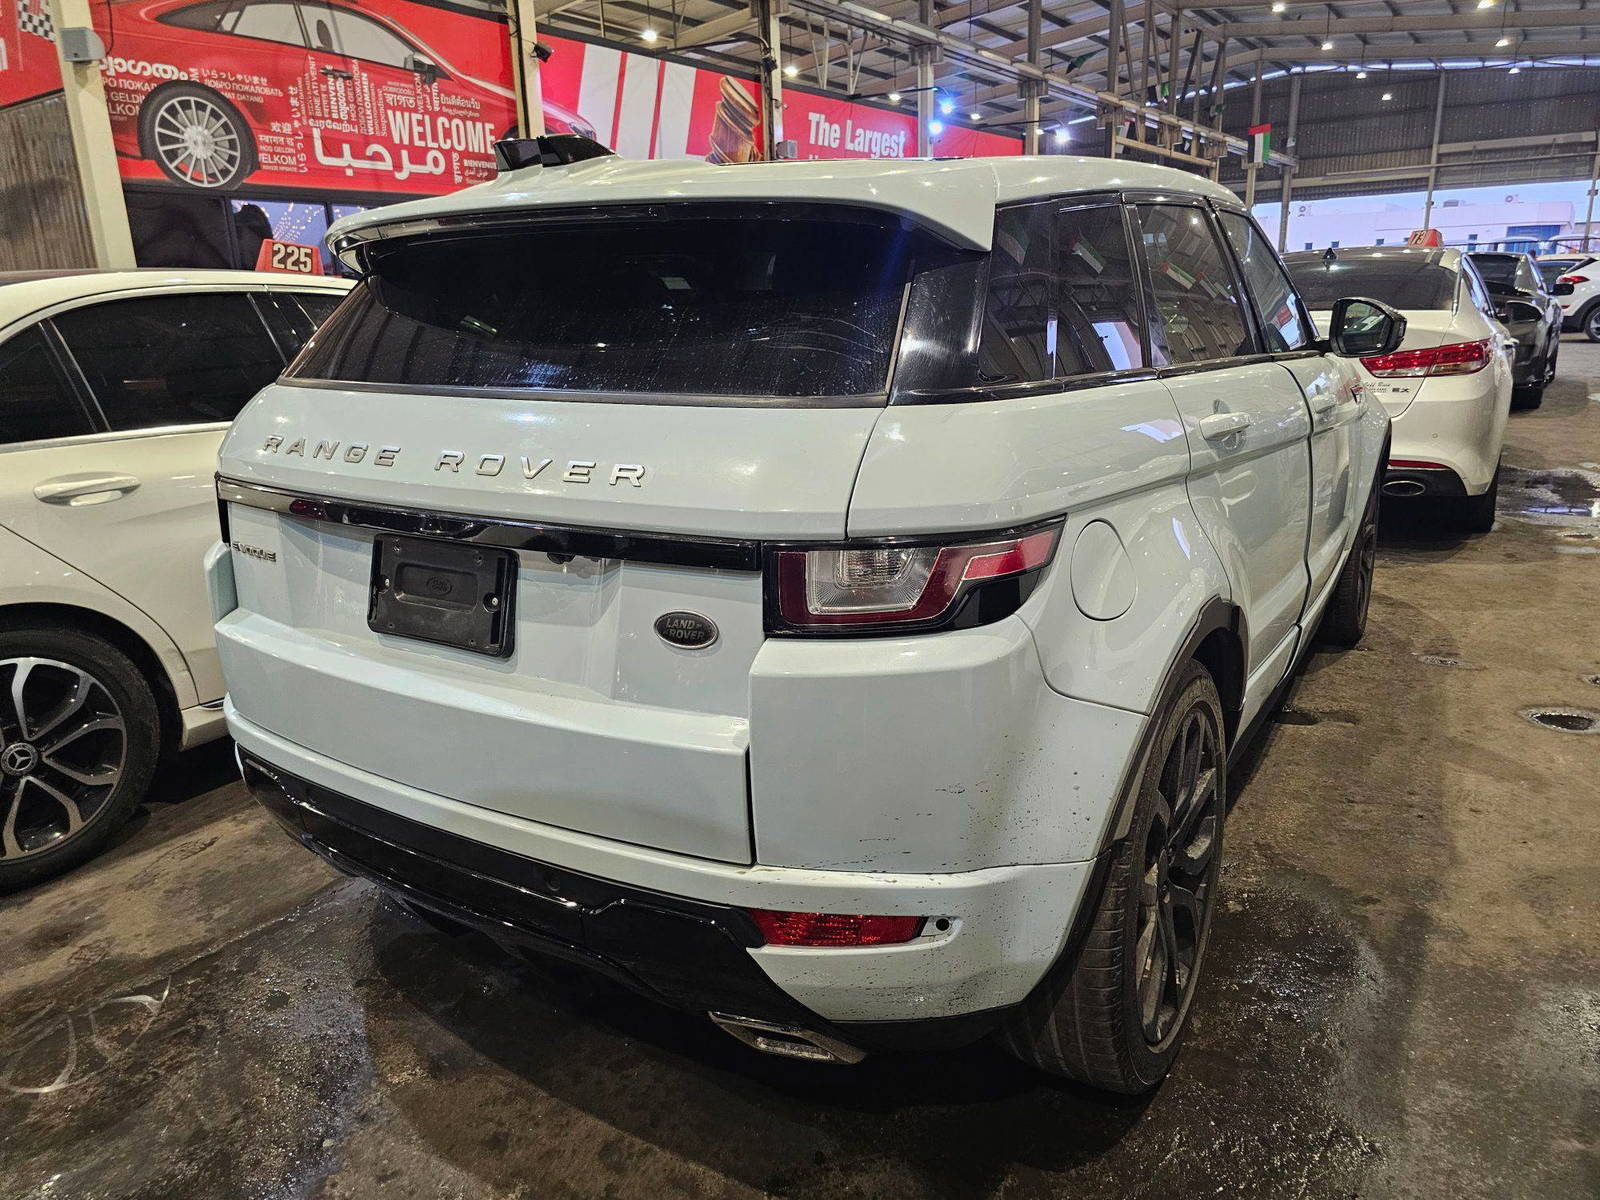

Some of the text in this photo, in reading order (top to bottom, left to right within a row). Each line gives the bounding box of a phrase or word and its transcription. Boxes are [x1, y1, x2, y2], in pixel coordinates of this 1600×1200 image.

[361, 72, 374, 135] WILLKOMMEN
[312, 127, 446, 180] مرحبا
[387, 109, 496, 154] WELCOME
[808, 111, 906, 158] The Largest
[272, 243, 312, 273] 225
[263, 434, 646, 487] RANGE ROVER
[666, 618, 696, 630] LAND
[668, 629, 705, 641] ROVER
